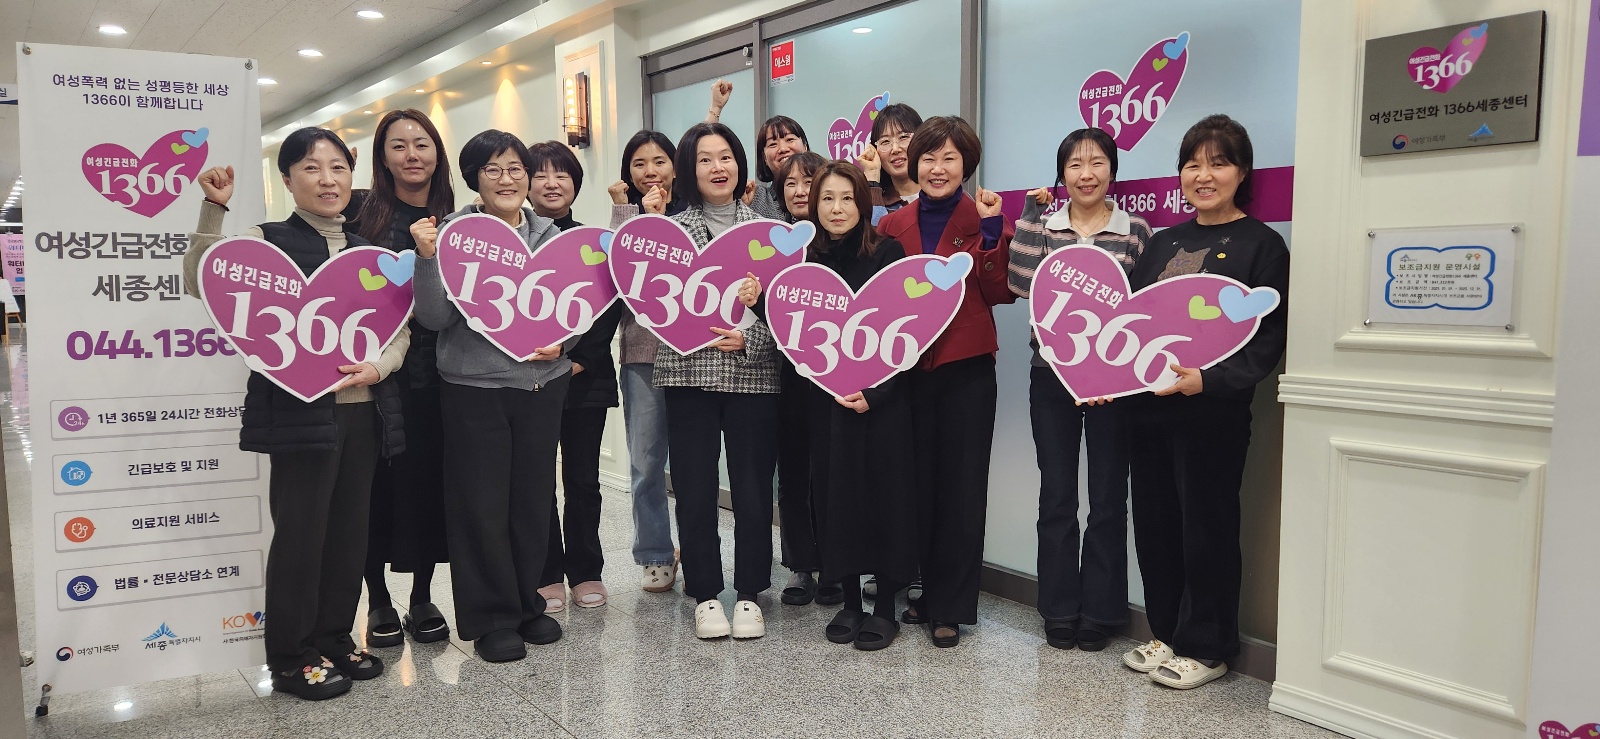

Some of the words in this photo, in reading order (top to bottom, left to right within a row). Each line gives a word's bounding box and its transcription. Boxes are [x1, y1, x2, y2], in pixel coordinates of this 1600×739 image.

[53, 74, 108, 89] 여성폭력
[114, 77, 140, 91] 없는
[145, 79, 198, 94] 성평등한
[203, 83, 229, 97] 세상
[1414, 52, 1473, 90] 1366
[83, 93, 131, 107] 1366이
[136, 96, 203, 111] 함께합니다
[1081, 84, 1123, 100] 여성긴급전화
[1369, 105, 1440, 125] 여성긴급전화
[1443, 94, 1529, 115] 1366세종센터
[86, 157, 138, 168] 여성긴급전화
[96, 162, 192, 208] 1366
[449, 231, 527, 270] 여성긴급전화
[620, 232, 694, 268] 여성긴급전화
[212, 257, 303, 298] 여성긴급전화
[1398, 263, 1440, 271] 보조금지원
[92, 274, 190, 302] 세종센
[448, 261, 594, 335] 1366
[776, 284, 850, 313] 여성긴급전화
[1049, 259, 1124, 310] 여성긴급전화
[225, 291, 382, 371] 1366
[778, 307, 920, 372] 1366
[1032, 289, 1193, 392] 1366
[98, 412, 117, 424] 1년
[121, 410, 157, 423] 365일
[161, 408, 200, 421] 24시간
[127, 461, 177, 476] 긴급보호
[181, 461, 192, 472] 및
[196, 458, 219, 471] 지원
[132, 515, 180, 530] 의료지원
[184, 512, 220, 525] 서비스
[114, 577, 139, 590] 법률
[152, 568, 213, 585] 전문상담소
[216, 565, 240, 579] 연계
[77, 644, 120, 656] 여성가족부
